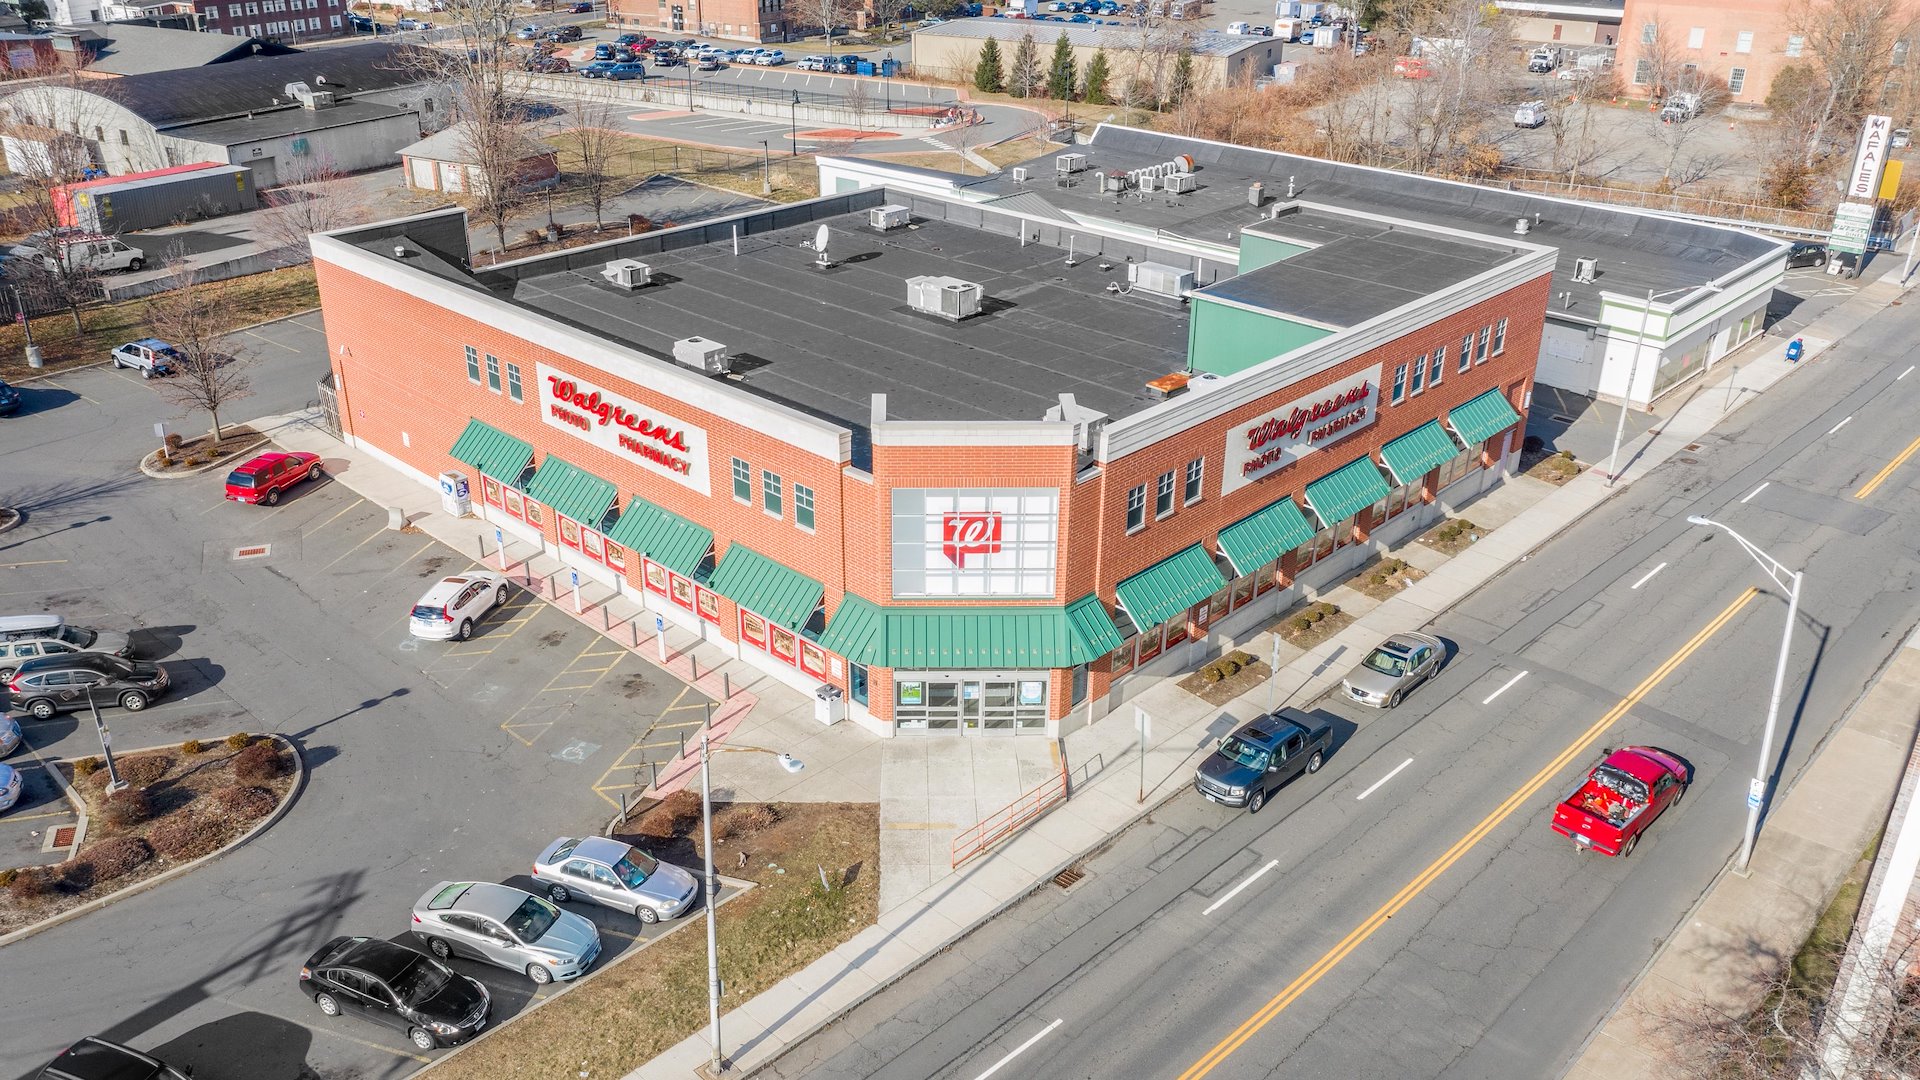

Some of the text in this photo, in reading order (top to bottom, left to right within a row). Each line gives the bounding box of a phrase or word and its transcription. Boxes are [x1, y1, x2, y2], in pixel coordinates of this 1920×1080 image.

[1856, 119, 1885, 193] MAFALES
[547, 375, 690, 453] Walgreens
[551, 405, 590, 431] PHOTO
[1246, 380, 1371, 450] Walgreens
[1308, 407, 1368, 445] PHARMACY
[618, 434, 691, 475] PHARMACY
[1241, 447, 1281, 476] PHOTO
